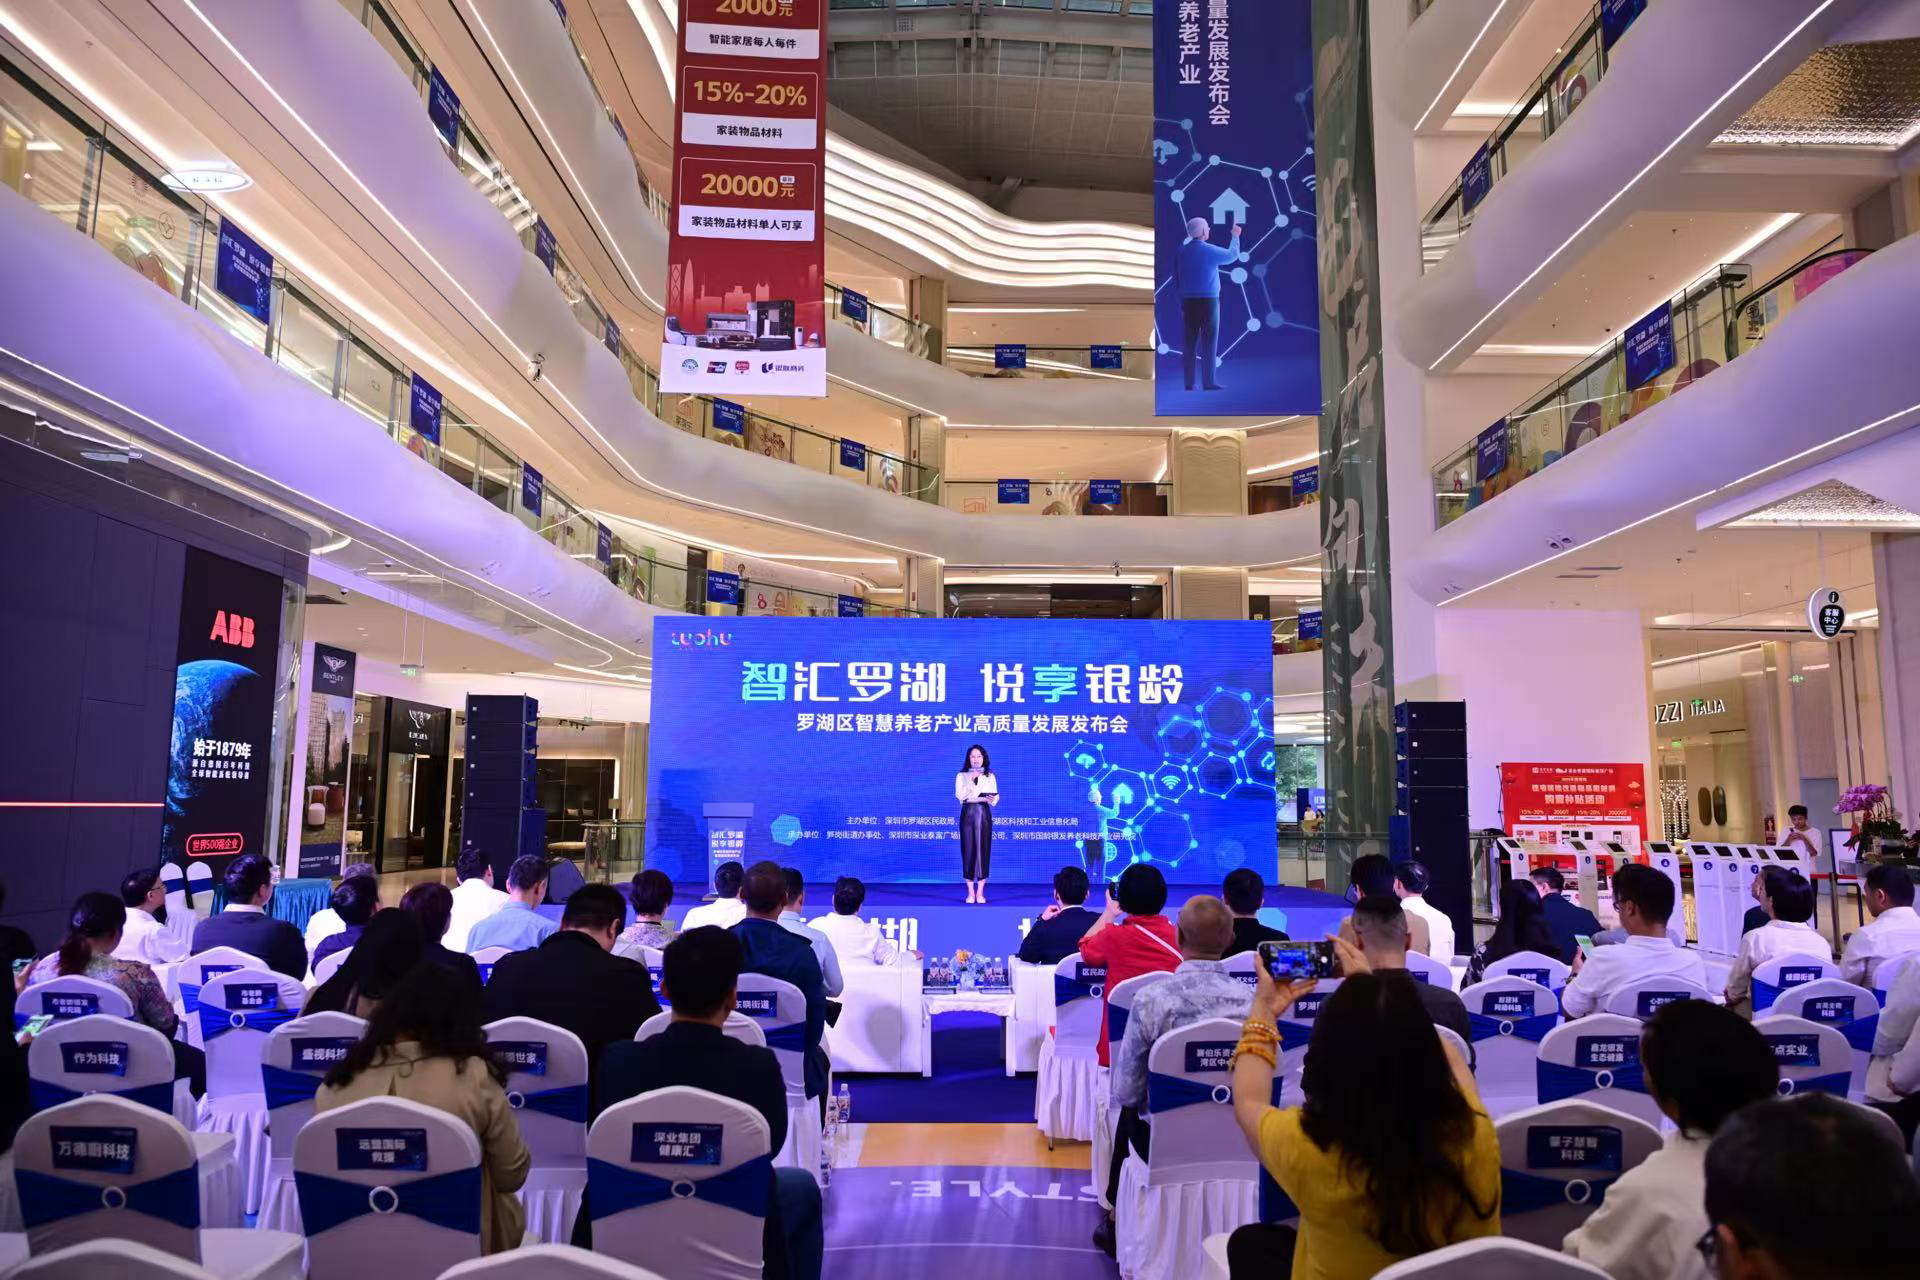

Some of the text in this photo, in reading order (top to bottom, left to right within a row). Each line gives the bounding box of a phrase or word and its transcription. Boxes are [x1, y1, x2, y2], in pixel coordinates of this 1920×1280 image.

[709, 33, 797, 49] 智能家居每人每件
[693, 80, 807, 106] 15%-20%
[716, 125, 783, 139] 家装物品材料
[691, 216, 803, 231] 家装物品材料单人可享
[1824, 616, 1839, 625] 中心
[209, 609, 256, 649] ABB
[741, 661, 1183, 704] 智汇罗湖 悦享银龄
[796, 713, 1129, 735] 罗湖区智慧养老产业高质量发展发布会
[193, 737, 252, 760] 始于1879年
[1082, 968, 1107, 976] 区民政
[74, 1051, 120, 1065] 作为科技
[654, 1131, 702, 1145] 深业集团
